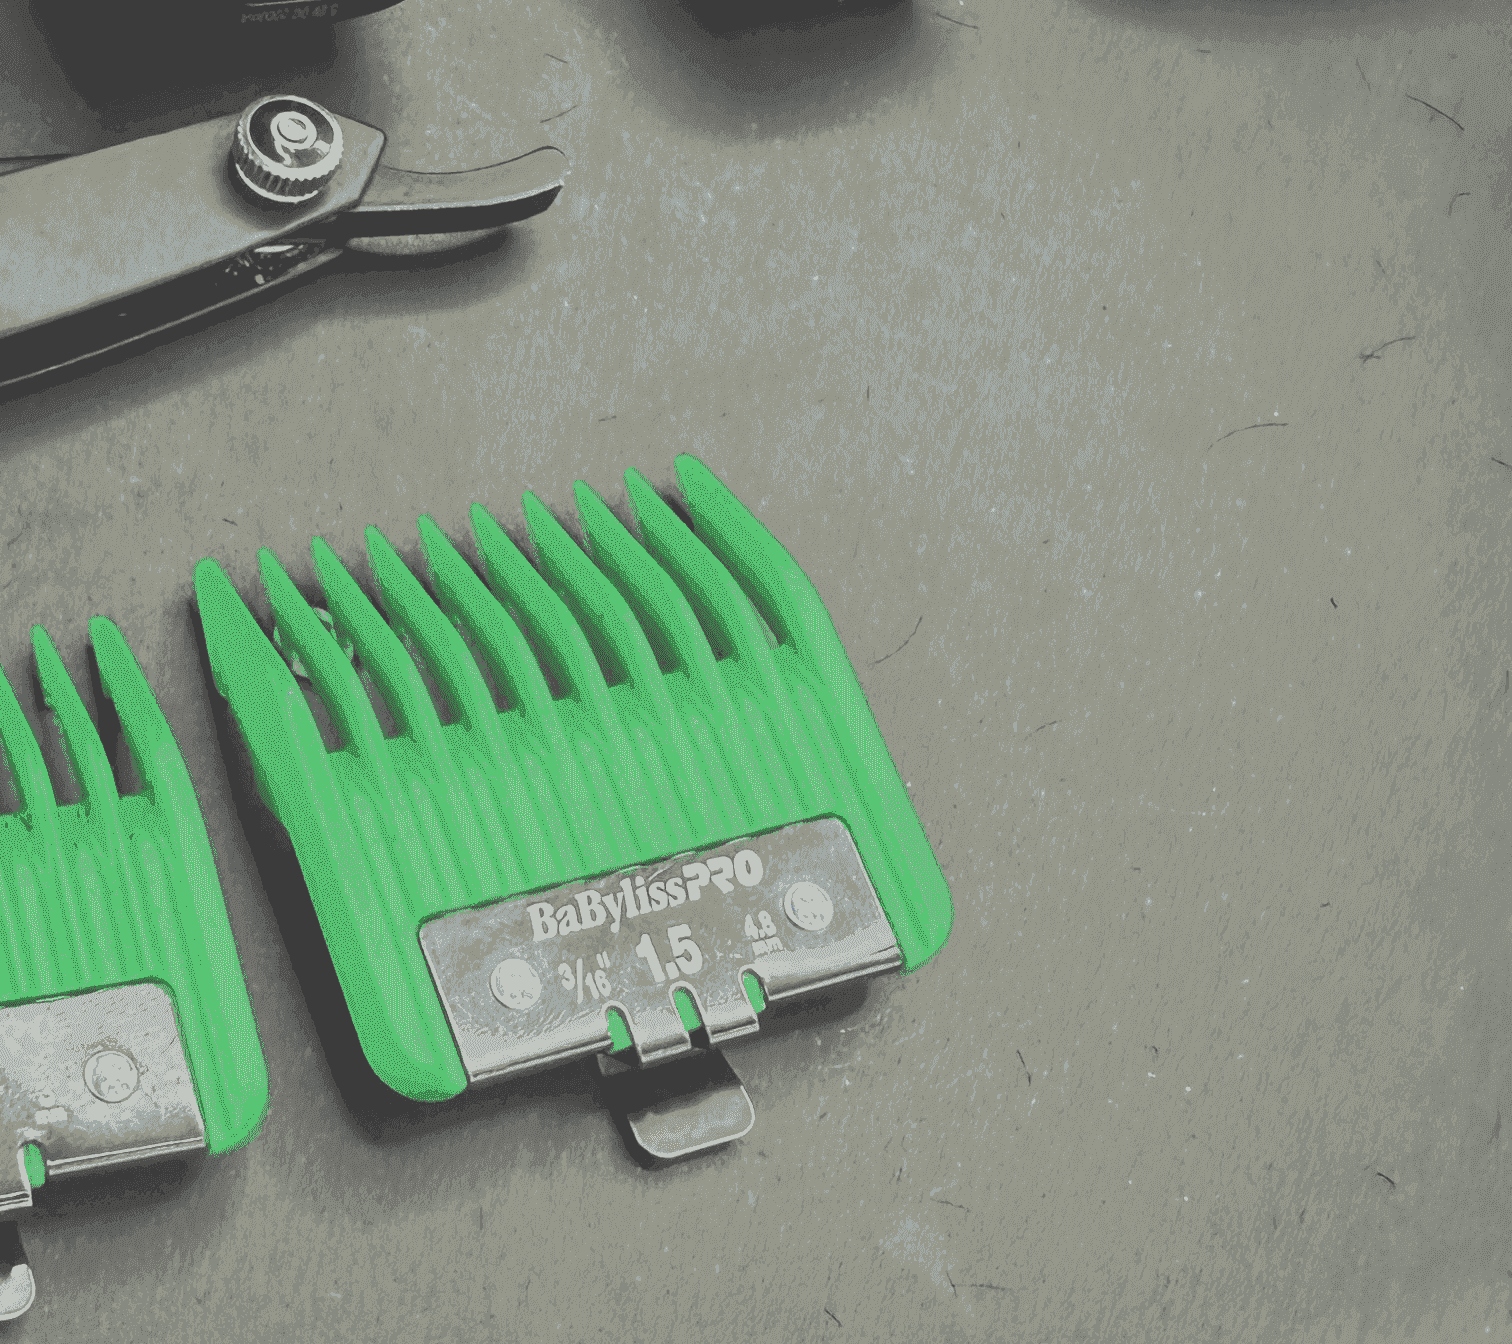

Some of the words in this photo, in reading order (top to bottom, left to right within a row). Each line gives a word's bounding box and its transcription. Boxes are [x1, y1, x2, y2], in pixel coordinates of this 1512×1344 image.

[527, 848, 765, 946] BaBylissPRO
[635, 923, 704, 984] 1.5
[744, 909, 779, 941] 4.8
